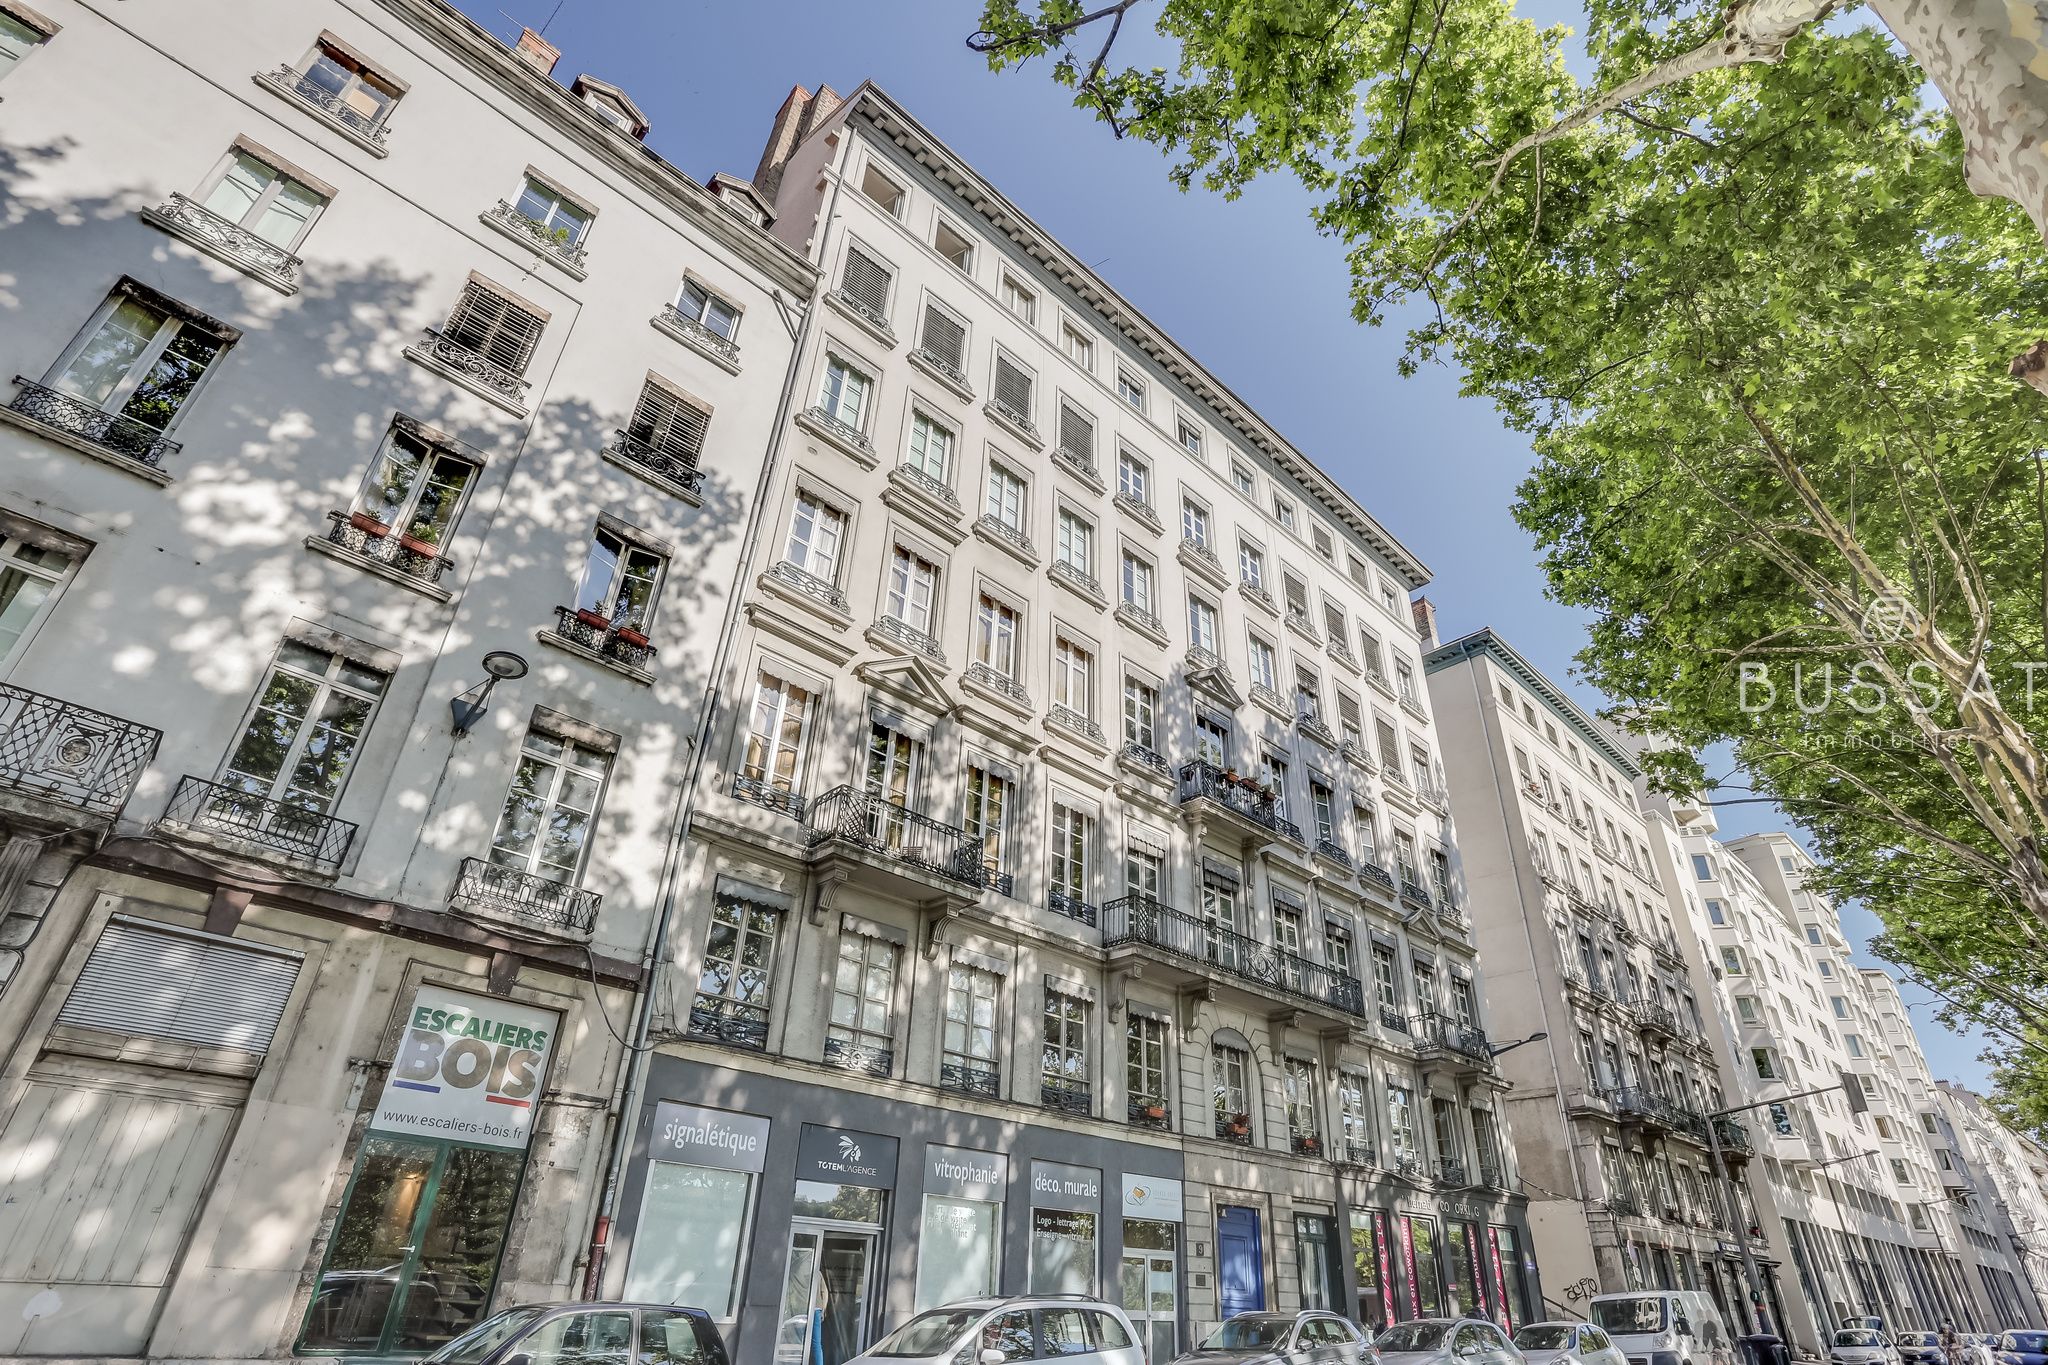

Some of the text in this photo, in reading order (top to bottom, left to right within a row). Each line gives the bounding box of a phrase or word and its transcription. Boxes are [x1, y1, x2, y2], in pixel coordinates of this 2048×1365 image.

[411, 1006, 549, 1052] ESCALIERS
[395, 1029, 542, 1099] BOIS
[383, 1110, 524, 1141] www.escaliers-bois.fr
[663, 1117, 757, 1157] signalétique
[934, 1157, 998, 1186] vitrophanie
[1064, 1177, 1098, 1198] murale
[1036, 1227, 1062, 1241] Enseigne
[1037, 1214, 1052, 1228] Logo
[1056, 1216, 1079, 1230] lettrage
[1079, 1218, 1093, 1230] PVC
[1401, 1220, 1414, 1281] coworking
